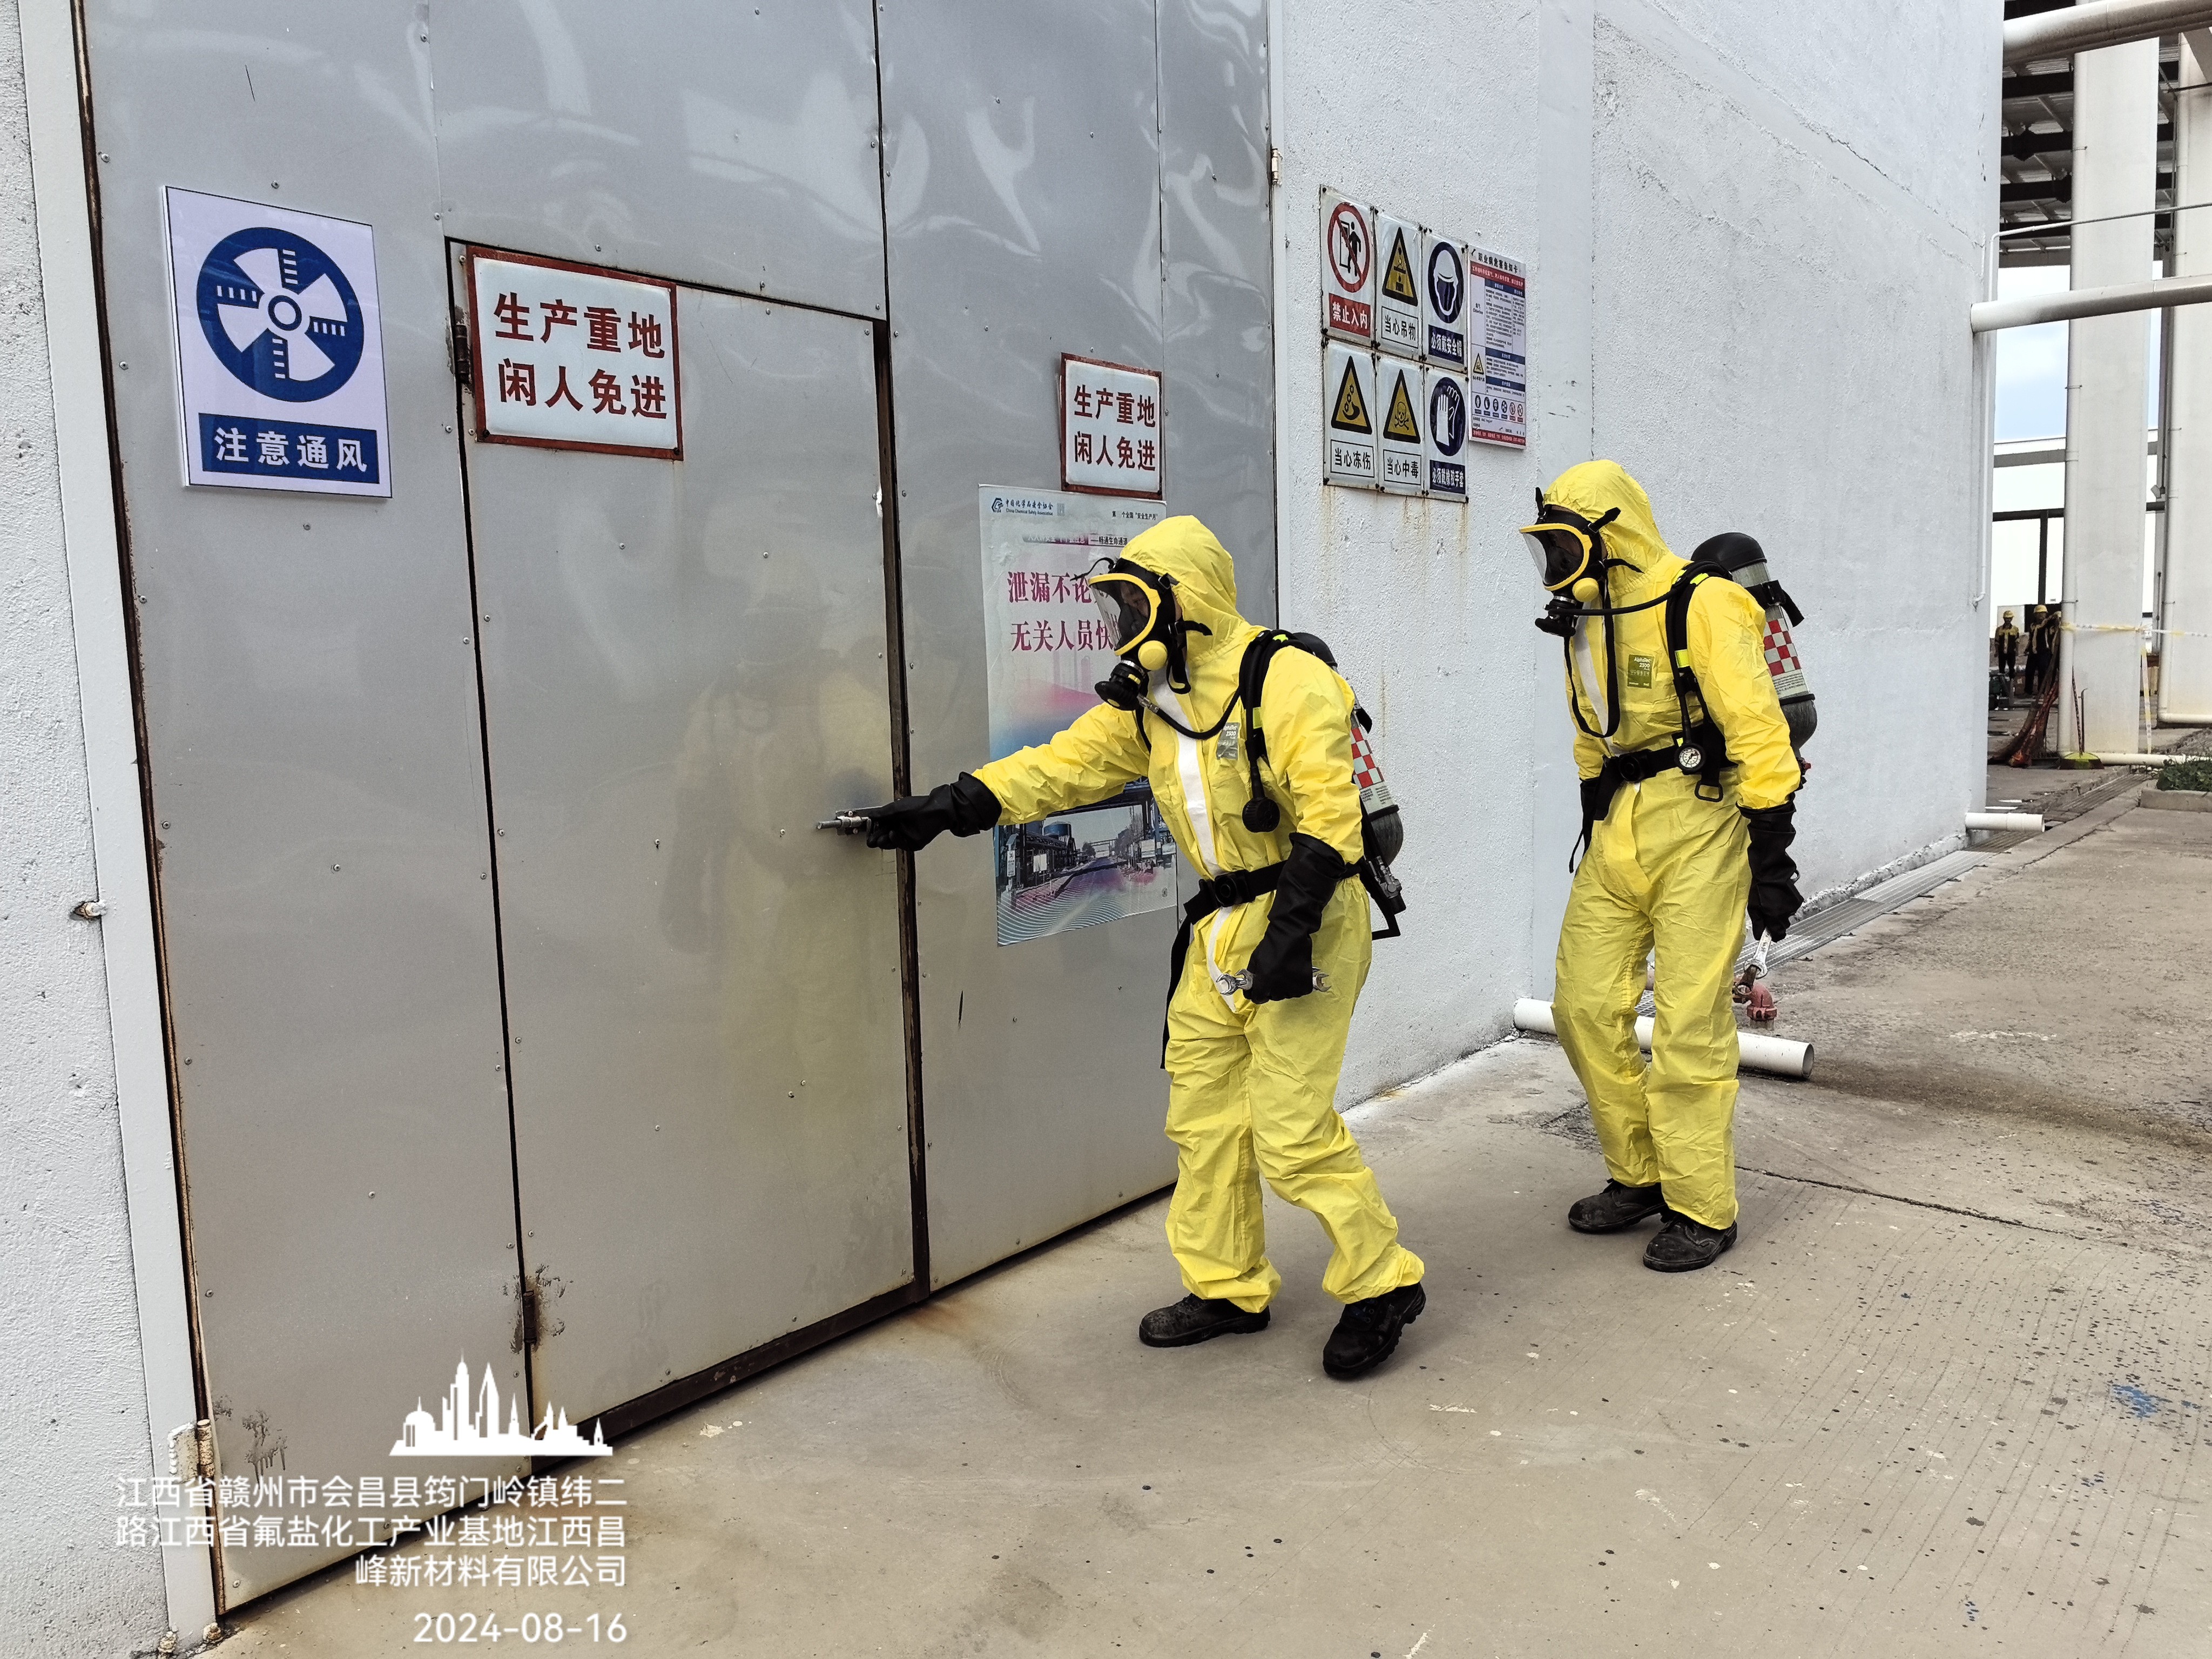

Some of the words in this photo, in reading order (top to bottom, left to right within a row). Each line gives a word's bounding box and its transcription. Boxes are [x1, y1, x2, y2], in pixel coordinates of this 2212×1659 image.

[1478, 252, 1518, 274] 职业病危害告知卡
[494, 292, 665, 359] 生产重地
[1332, 301, 1367, 330] 禁止入内
[1385, 314, 1417, 341] 当心吊物
[1431, 332, 1462, 357] 必须戴安全帽
[498, 358, 667, 419] 闲人免进
[1074, 384, 1156, 428] 生产重地
[214, 427, 367, 472] 注意通风
[1074, 431, 1156, 471] 闲人免进
[1334, 447, 1372, 471] 当心冻伤
[1387, 456, 1419, 479] 当心中毒
[1007, 571, 1097, 604] 泄漏不论
[1010, 619, 1117, 652] 无关人员快
